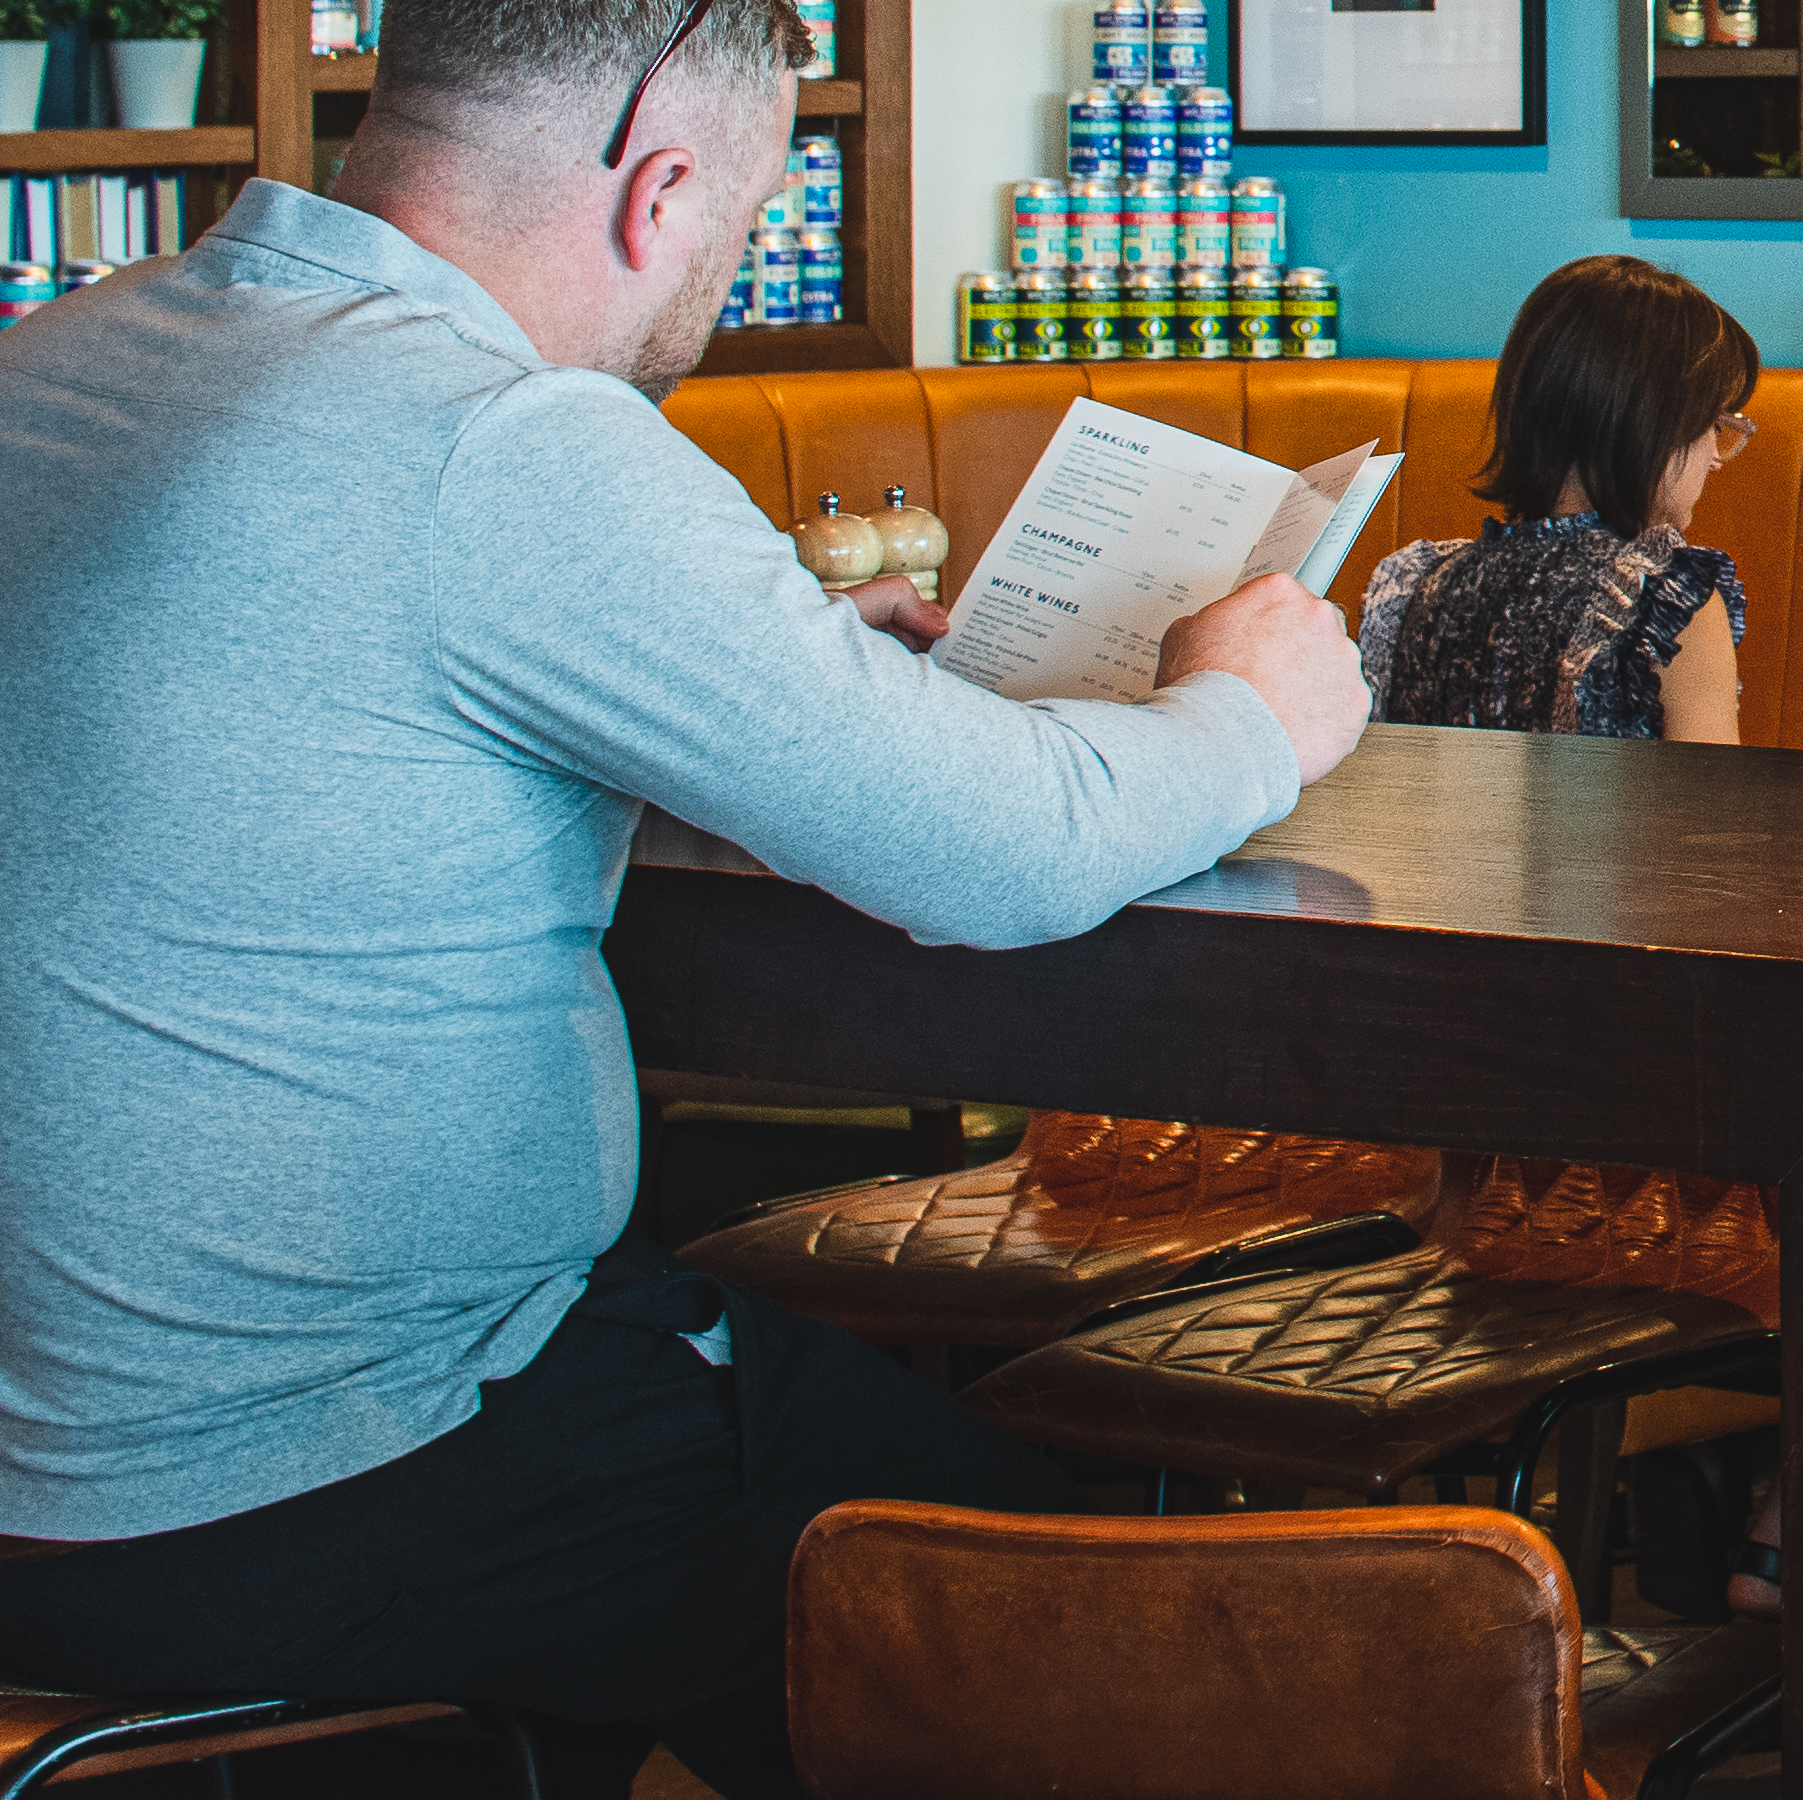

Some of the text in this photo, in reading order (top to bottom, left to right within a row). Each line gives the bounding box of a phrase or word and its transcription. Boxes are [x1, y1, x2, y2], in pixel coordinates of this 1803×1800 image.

[1078, 425, 1151, 455] SPARKLING
[1021, 523, 1103, 558] CHAMPAGNE
[990, 575, 1081, 614] WHITE WINES
